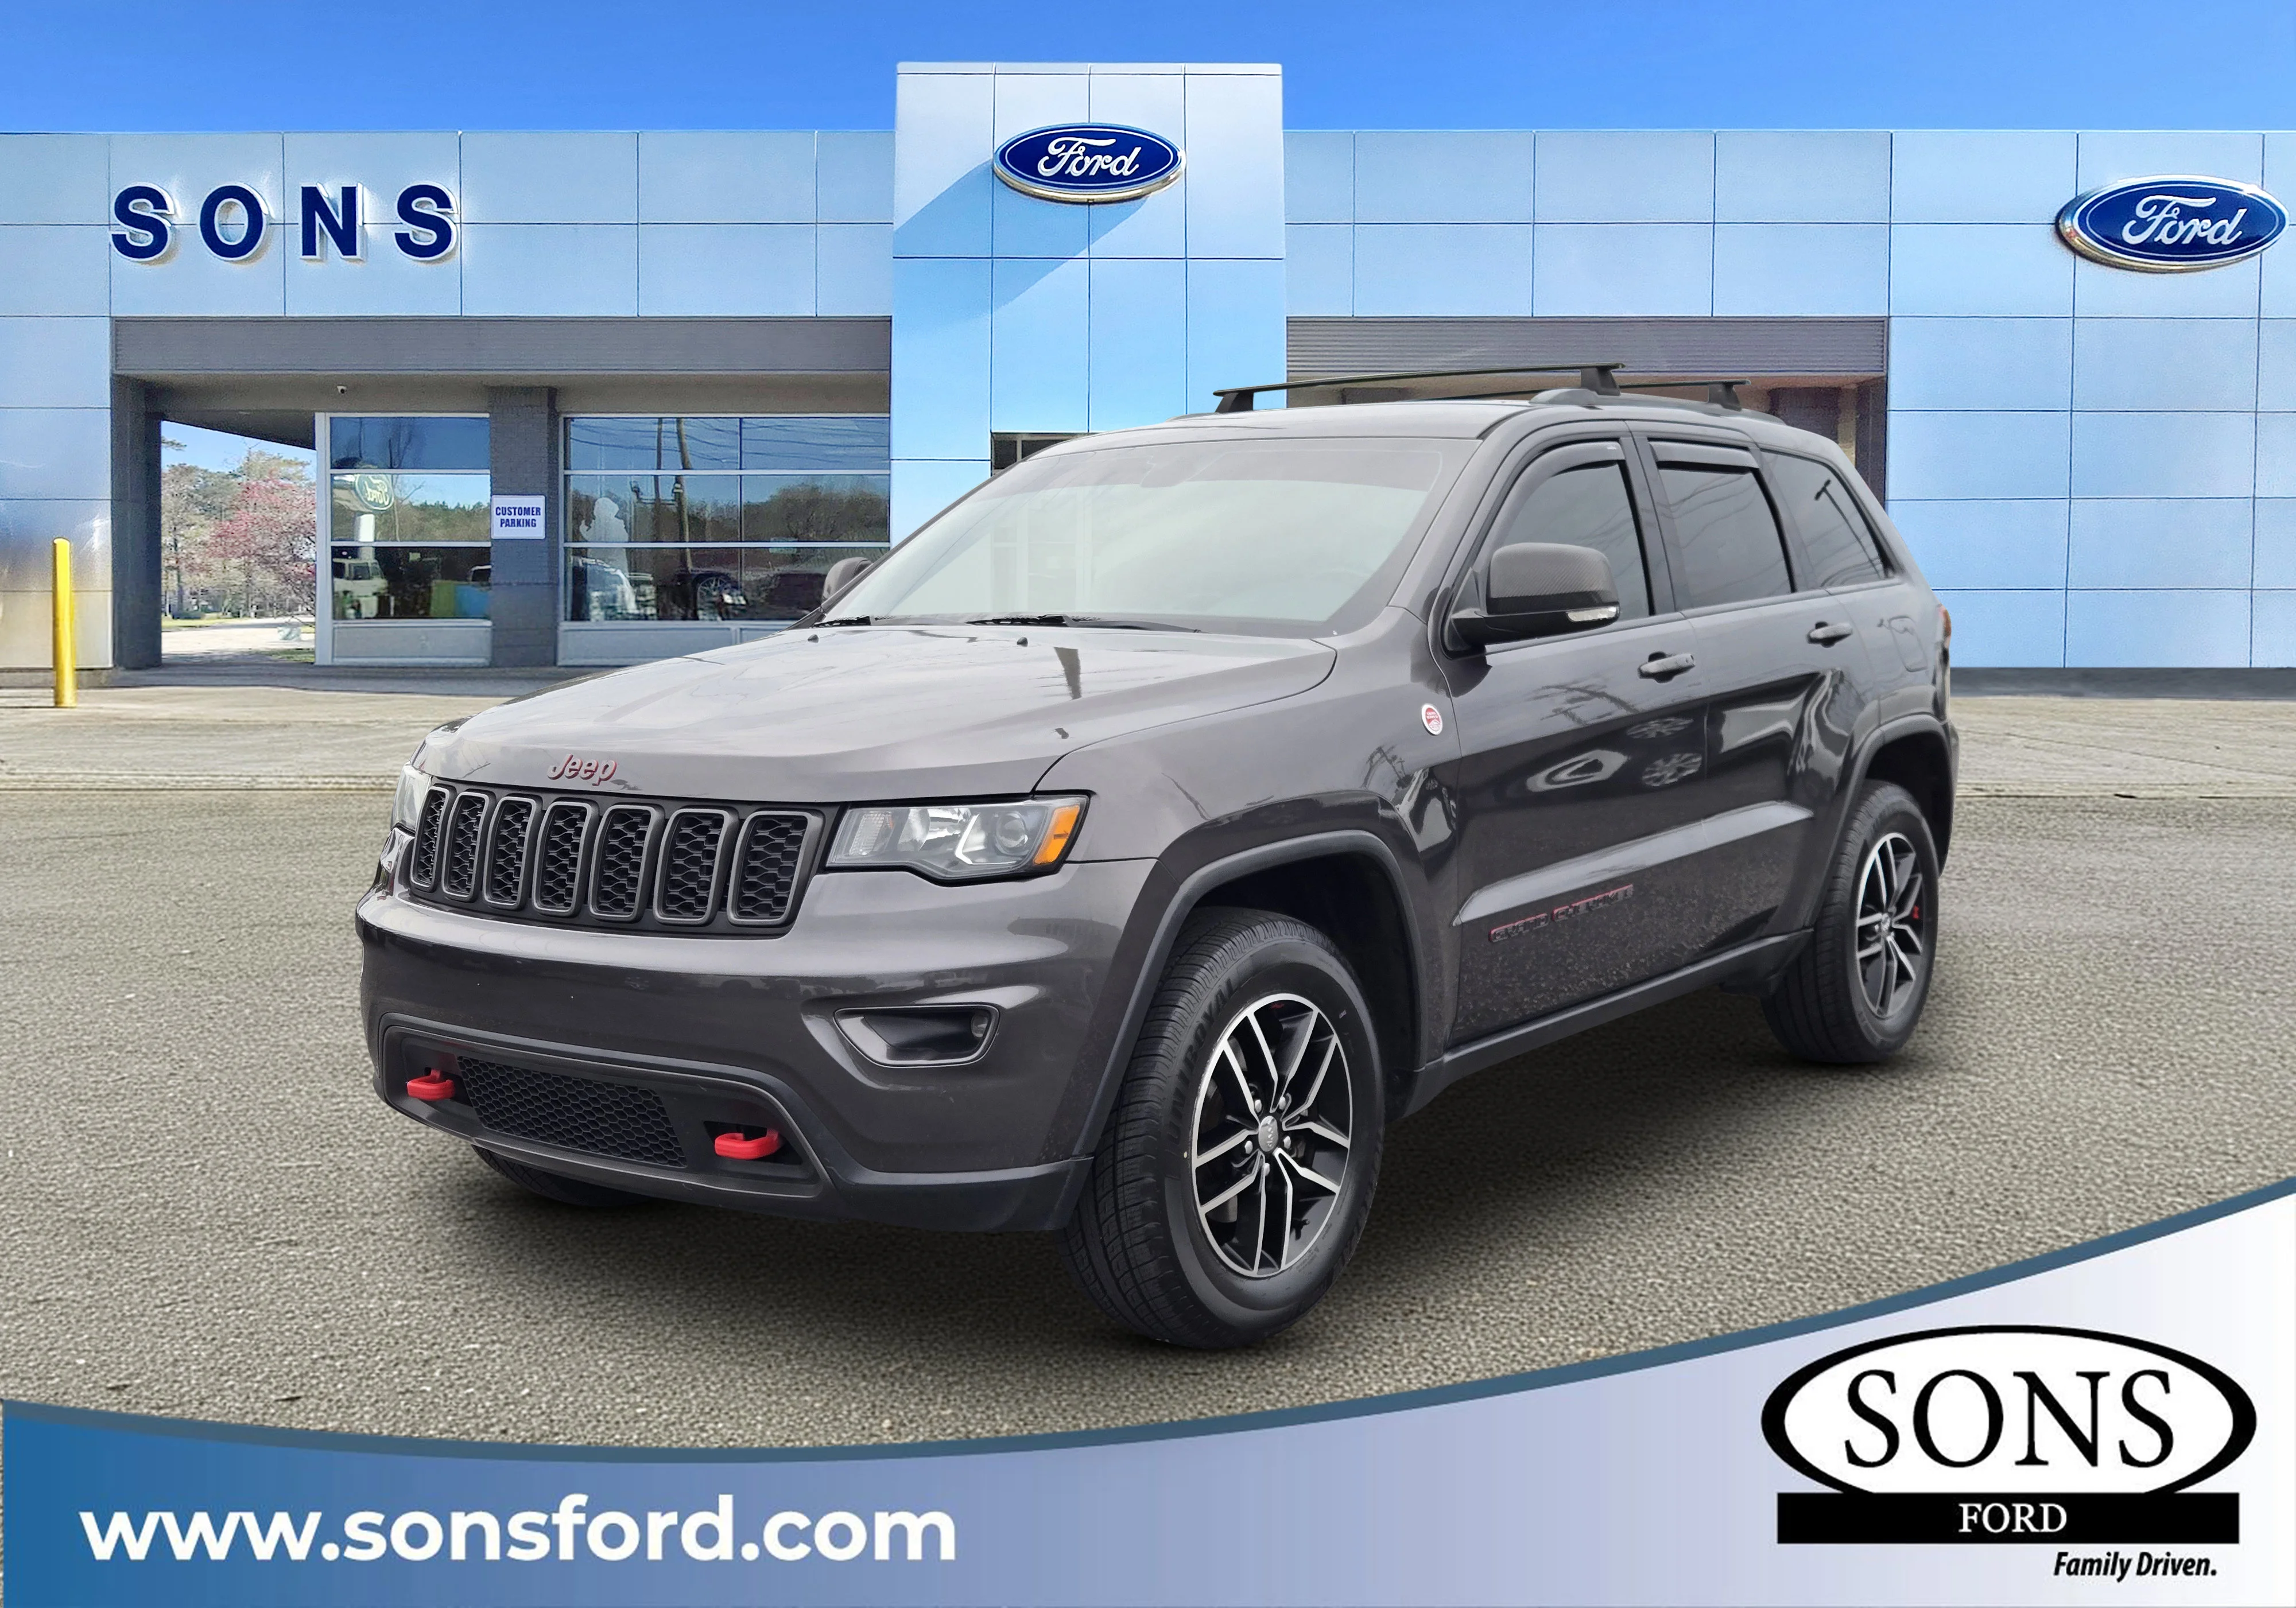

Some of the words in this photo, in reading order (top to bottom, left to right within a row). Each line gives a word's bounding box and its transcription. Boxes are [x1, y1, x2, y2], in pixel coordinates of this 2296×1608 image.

[1037, 137, 1142, 177] Ford
[111, 184, 460, 261] SONS
[2122, 195, 2247, 245] Ford
[495, 507, 541, 516] CUSTOMER
[500, 519, 537, 527] PARKING
[547, 753, 618, 786] Jeep
[1167, 978, 1238, 1145] UNIROYAL
